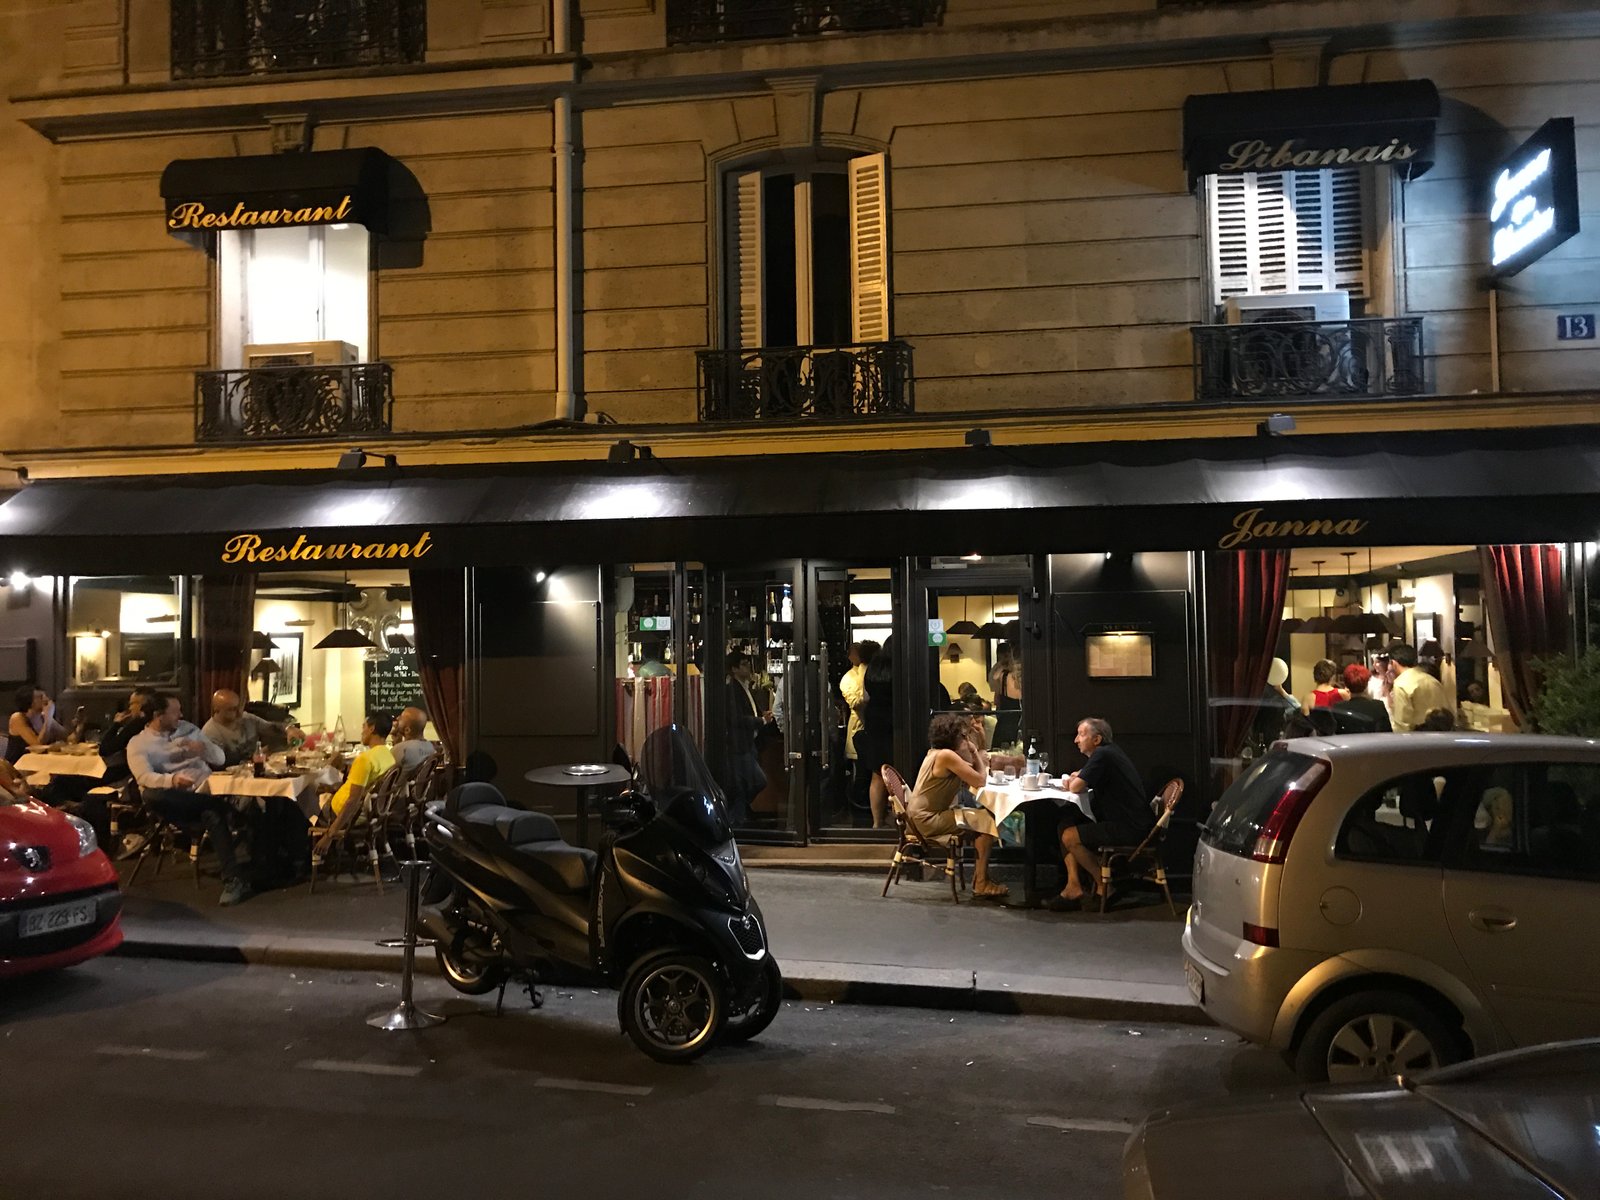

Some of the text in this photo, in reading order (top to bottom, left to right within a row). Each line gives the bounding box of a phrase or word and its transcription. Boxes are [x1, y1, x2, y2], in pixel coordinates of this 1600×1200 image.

[1220, 139, 1417, 170] Libanais
[168, 195, 353, 229] Restaurant
[1565, 316, 1588, 338] 13
[1218, 508, 1369, 549] Janna
[221, 531, 433, 563] Restaurant
